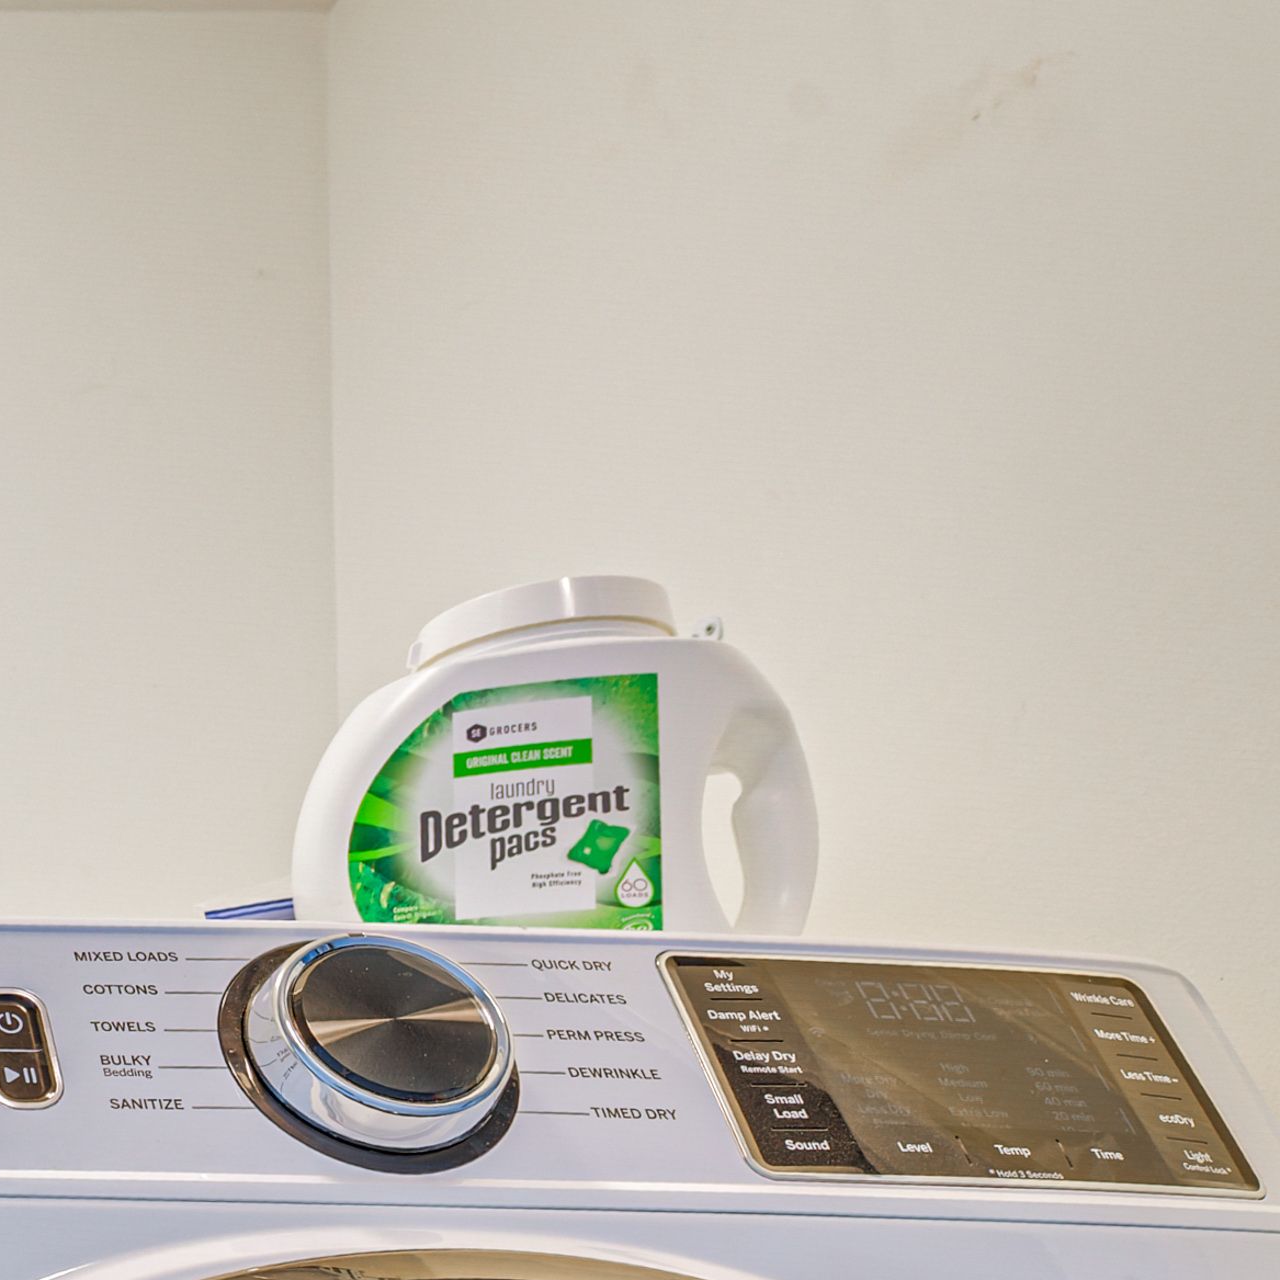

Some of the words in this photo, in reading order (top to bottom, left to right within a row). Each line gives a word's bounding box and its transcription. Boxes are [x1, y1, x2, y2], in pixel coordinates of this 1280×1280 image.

[489, 722, 537, 736] GROCERS
[466, 753, 509, 769] ORIGINAL
[511, 750, 541, 763] CLEAN
[543, 746, 574, 760] SCENT
[491, 778, 555, 800] laundry
[420, 785, 630, 863] Detergent
[491, 826, 557, 871] pacs
[622, 879, 647, 892] 60
[74, 952, 124, 962] MIXED
[128, 952, 179, 962] LOADS
[531, 960, 580, 971] QUICK
[584, 961, 613, 972] DRY
[713, 970, 734, 982] My
[83, 985, 159, 996] COTTONS
[704, 982, 759, 995] Settings
[544, 993, 627, 1005] DELICATES
[1070, 992, 1110, 1005] Wrinkle
[1109, 996, 1135, 1008] Care
[707, 1010, 746, 1022] Damp
[749, 1010, 781, 1021] Alert
[90, 1022, 157, 1033] TOWELS
[546, 1030, 592, 1041] PERM
[595, 1031, 645, 1042] PRESS
[1094, 1029, 1122, 1041] More
[1121, 1032, 1149, 1044] Time
[100, 1055, 152, 1066] BULKY
[733, 1051, 770, 1063] Delay
[773, 1051, 797, 1063] Dry
[103, 1068, 153, 1079] Bedding
[568, 1067, 662, 1080] DEWRINKLE
[741, 1065, 777, 1074] Remote
[778, 1066, 803, 1075] Start
[1120, 1069, 1146, 1081] Less
[1144, 1071, 1172, 1084] Time
[110, 1099, 185, 1110] SANITIZE
[764, 1094, 805, 1105] Small
[591, 1107, 642, 1120] TIMED
[646, 1109, 677, 1121] DRY
[774, 1109, 809, 1120] Load
[1159, 1114, 1196, 1128] ecoDry
[785, 1140, 831, 1151] Sound
[897, 1141, 933, 1154] Level
[994, 1144, 1032, 1157] Temp
[1091, 1148, 1125, 1161] Time
[1184, 1150, 1214, 1164] Light
[996, 1169, 1019, 1178] Hold
[1018, 1170, 1027, 1179] 3
[1026, 1170, 1065, 1180] Seconds
[1183, 1162, 1211, 1173] Control
[1209, 1165, 1229, 1175] Lock
